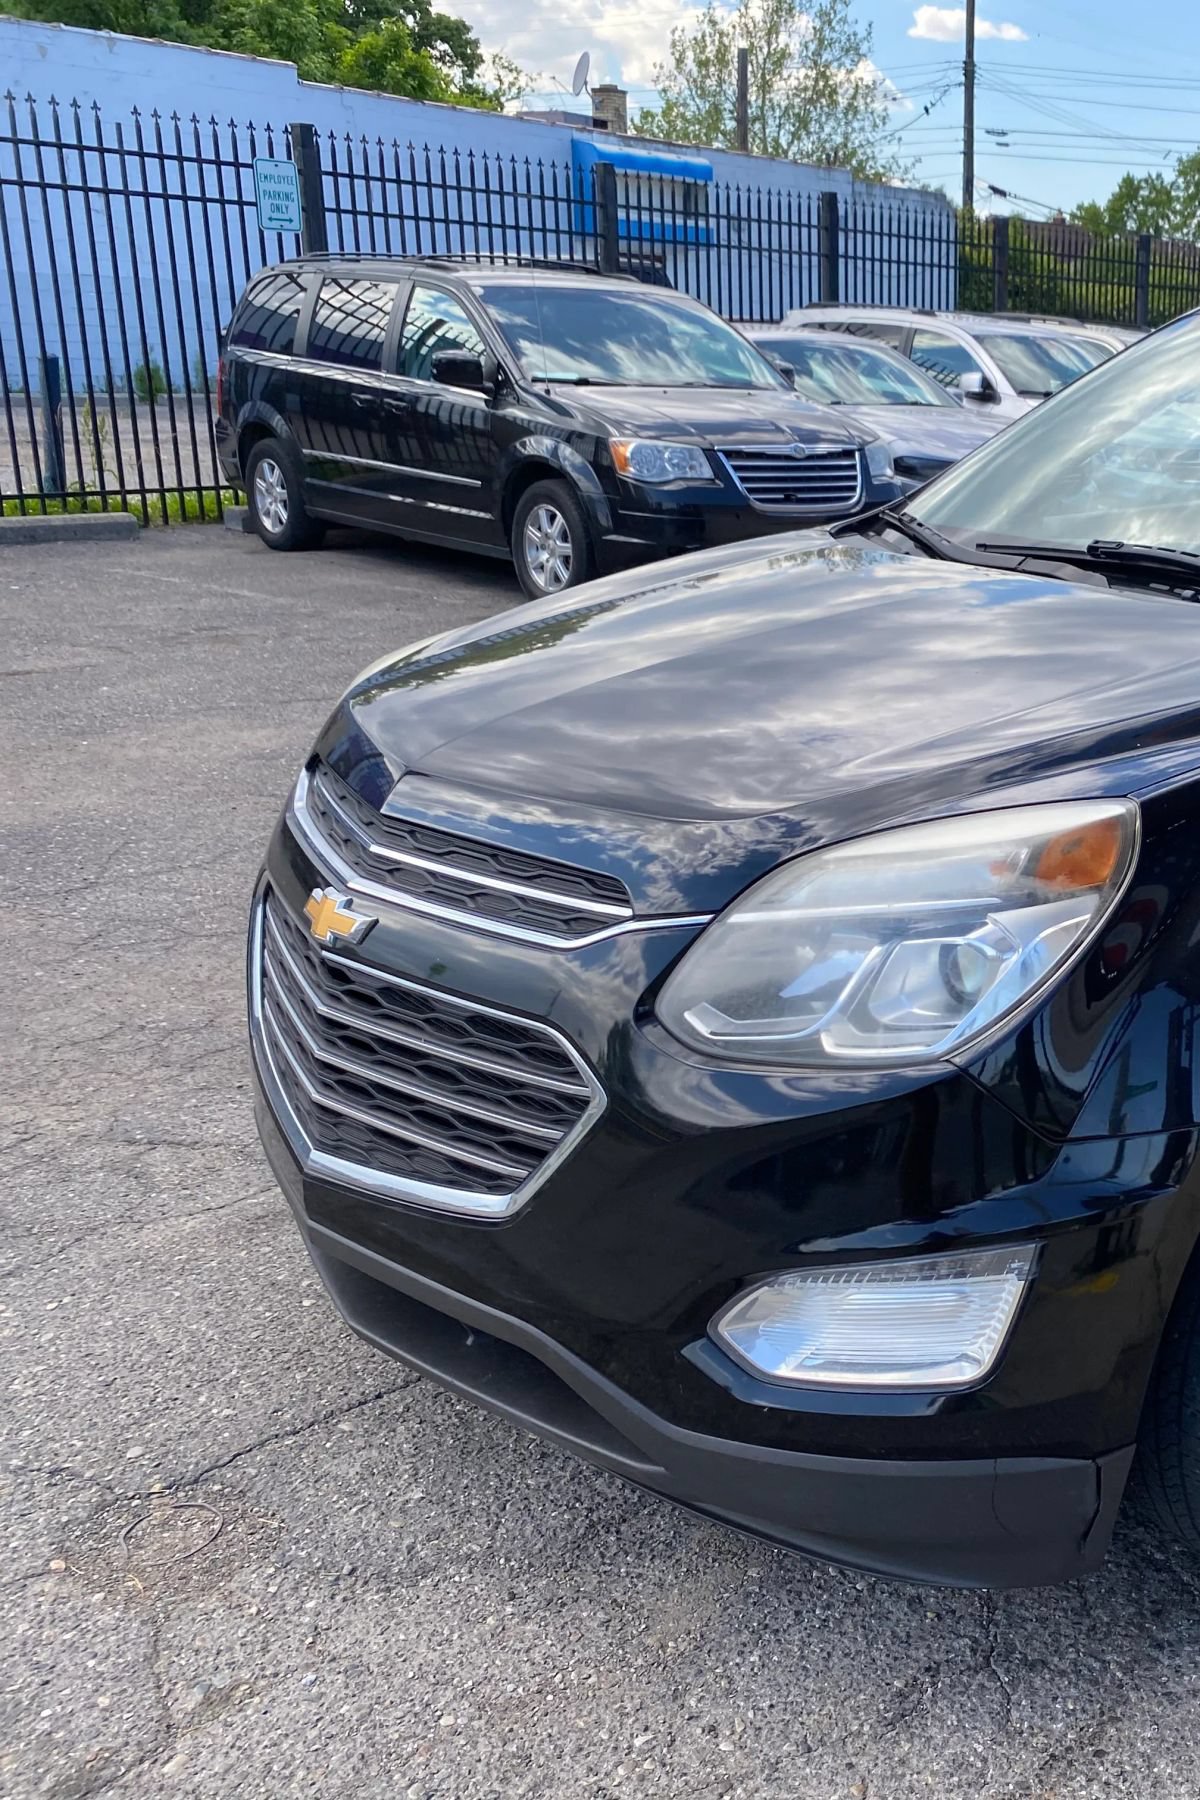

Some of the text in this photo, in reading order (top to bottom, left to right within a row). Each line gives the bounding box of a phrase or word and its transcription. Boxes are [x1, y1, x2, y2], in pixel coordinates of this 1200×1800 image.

[259, 173, 295, 185] EMPLOYEE
[263, 189, 294, 202] PARKING
[270, 203, 289, 214] ONLY
